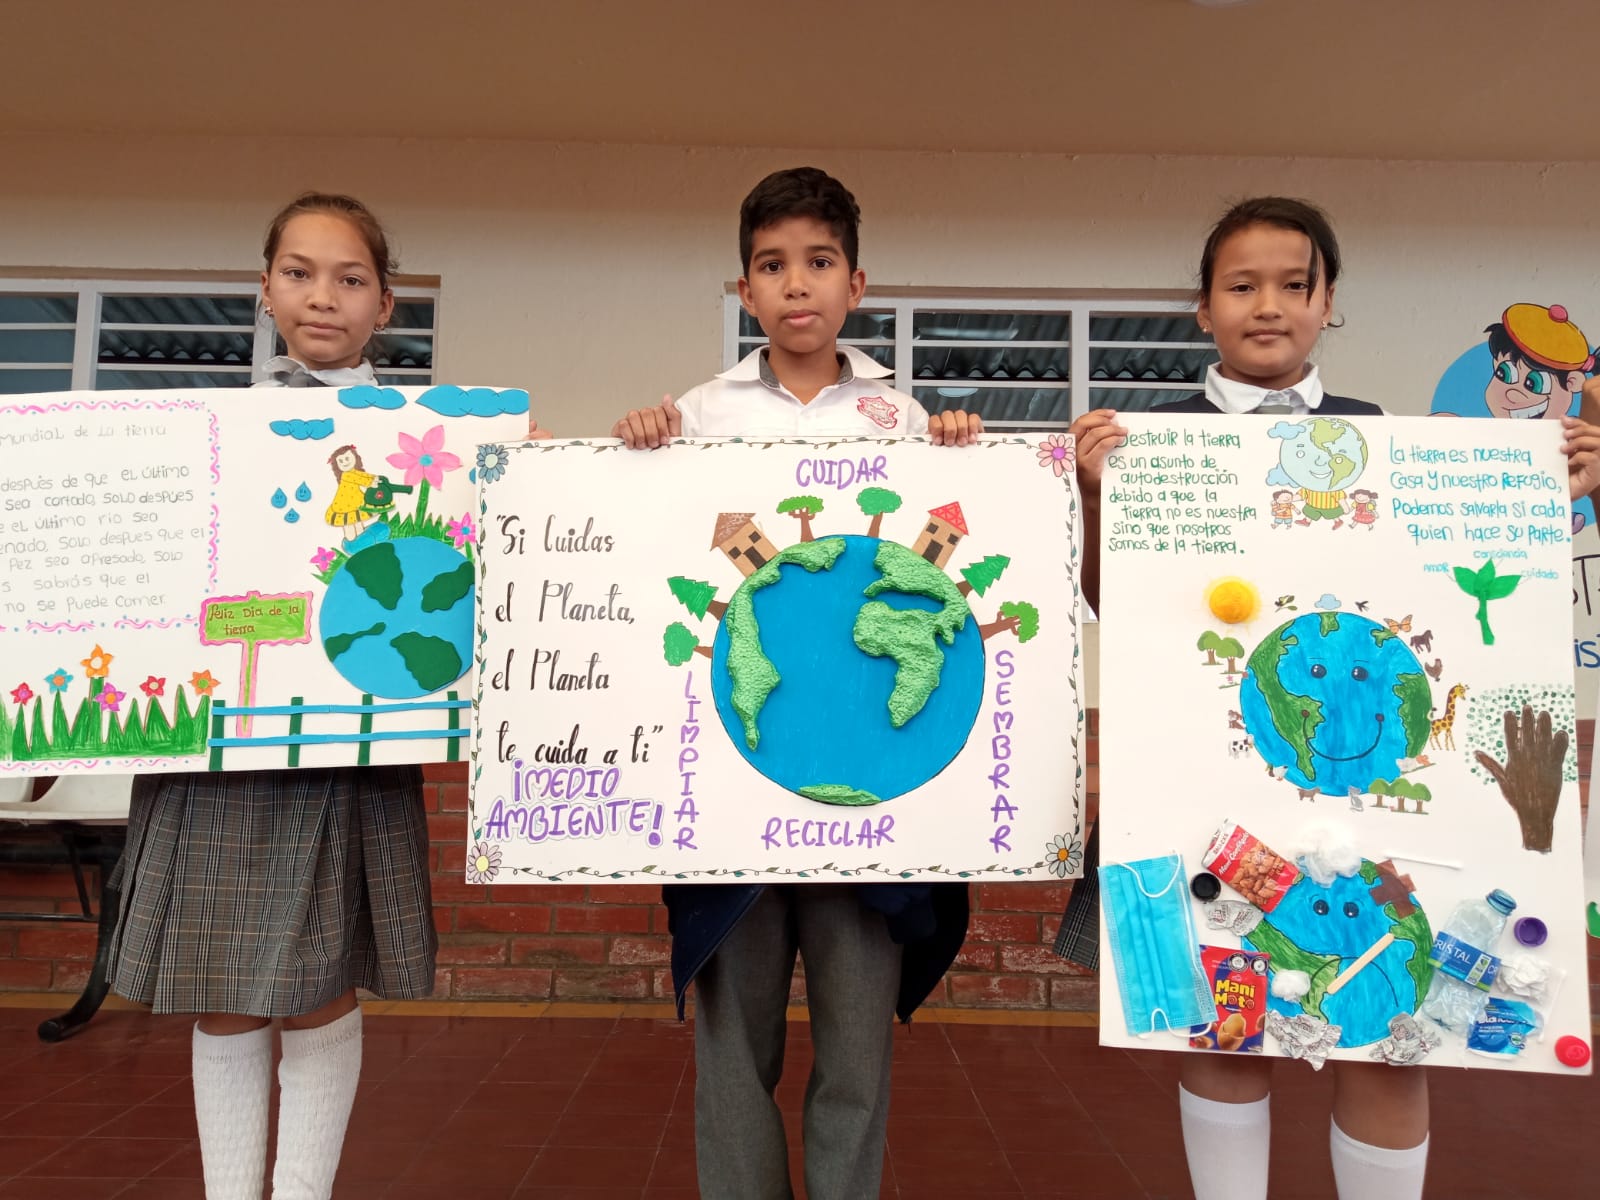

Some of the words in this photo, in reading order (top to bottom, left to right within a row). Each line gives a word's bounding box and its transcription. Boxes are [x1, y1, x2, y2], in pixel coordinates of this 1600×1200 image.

[1184, 428, 1194, 446] la
[1108, 455, 1127, 469] es
[1130, 456, 1147, 469] un
[1150, 453, 1195, 469] asunto
[1200, 454, 1217, 468] de
[1449, 451, 1468, 463] es
[62, 474, 78, 488] de
[84, 472, 108, 488] que
[796, 455, 888, 490] CUIDAR
[1109, 486, 1153, 503] debido
[1157, 490, 1166, 501] a
[1170, 490, 1196, 505] que
[1205, 488, 1218, 502] la
[1166, 507, 1181, 520] no
[1185, 508, 1202, 518] es
[1531, 499, 1565, 518] cada
[157, 528, 184, 542] que
[1147, 523, 1170, 538] que
[1407, 523, 1453, 545] quien
[1464, 523, 1500, 542] hace
[1154, 538, 1169, 551] de
[99, 573, 126, 588] que
[5, 602, 25, 613] no
[269, 605, 282, 616] de
[288, 605, 299, 615] la
[495, 581, 515, 622] el
[538, 579, 635, 625] Planeta,
[223, 624, 255, 636] tierra
[491, 648, 515, 692] el
[530, 648, 611, 691] Planeta
[496, 720, 517, 763] te
[534, 723, 589, 765] cuida
[603, 748, 619, 765] a
[988, 650, 1019, 853] SEMBRAR
[672, 670, 702, 851] LIMPIAR
[485, 799, 663, 846] AMBIENTE!
[761, 814, 895, 851] RECICLAR
[1432, 938, 1472, 965] RISTAL
